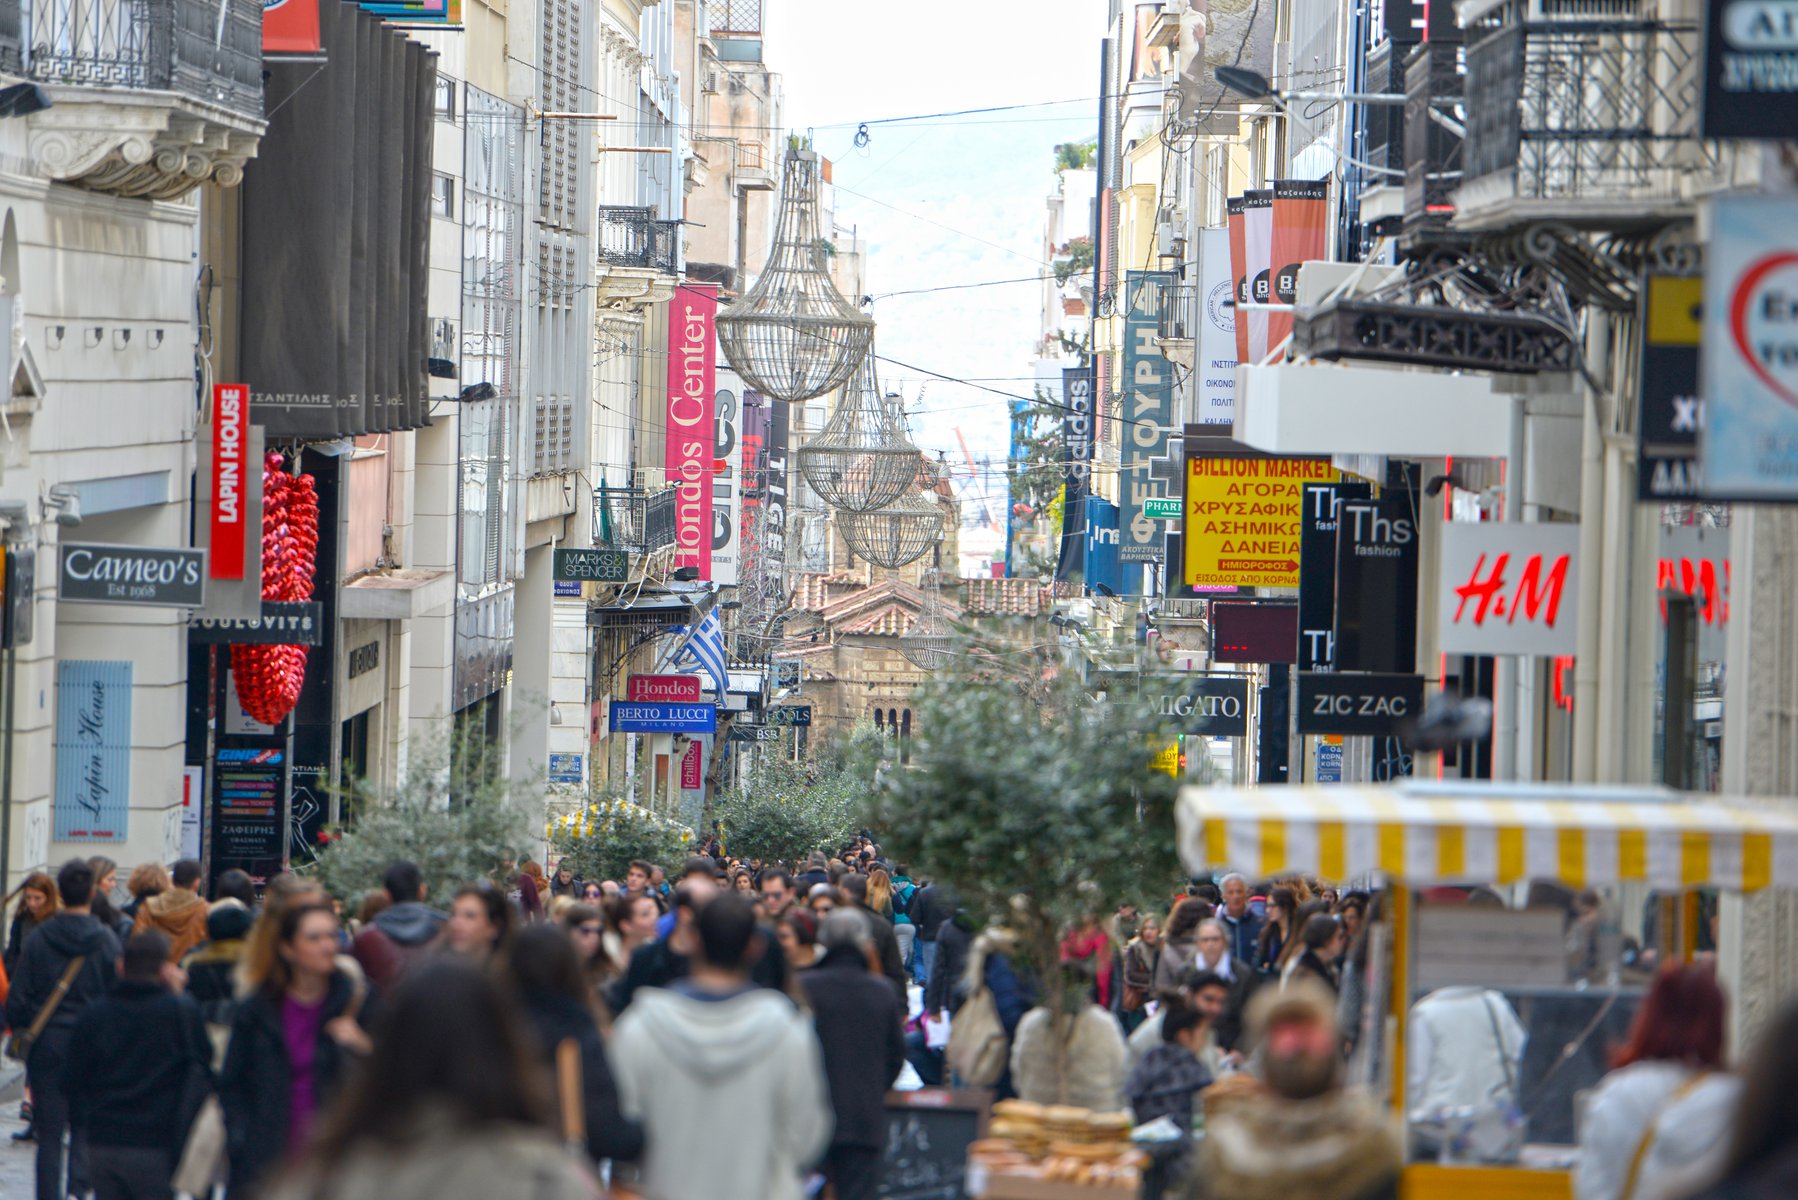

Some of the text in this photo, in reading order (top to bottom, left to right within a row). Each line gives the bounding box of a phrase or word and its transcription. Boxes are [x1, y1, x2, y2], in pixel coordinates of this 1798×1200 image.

[670, 305, 706, 568] Hondos Center
[1066, 380, 1089, 479] adidas
[218, 389, 241, 523] LAPIN HOUSE
[1193, 458, 1258, 477] BILLION
[1227, 482, 1300, 497] ΑΓΟΡΑ
[1346, 506, 1411, 543] Ths
[1355, 544, 1401, 556] fashion
[66, 550, 199, 584] Cameo's
[565, 564, 623, 577] SPENCER
[1222, 561, 1288, 570] ΗΜΙΟΡΟΦΟΣ
[1196, 574, 1237, 583] ΕΙΣΟΔΟΣ
[108, 583, 157, 600] Est 1968
[1453, 553, 1571, 628] H&M
[635, 680, 695, 695] Hondos
[617, 708, 708, 720] BERTO LUCCI
[1313, 695, 1407, 716] ZIC ZAC
[757, 729, 778, 740] BSB
[76, 680, 109, 824] Lapin House
[222, 826, 275, 834] ΖΑΦΕΙΡΗΣ
